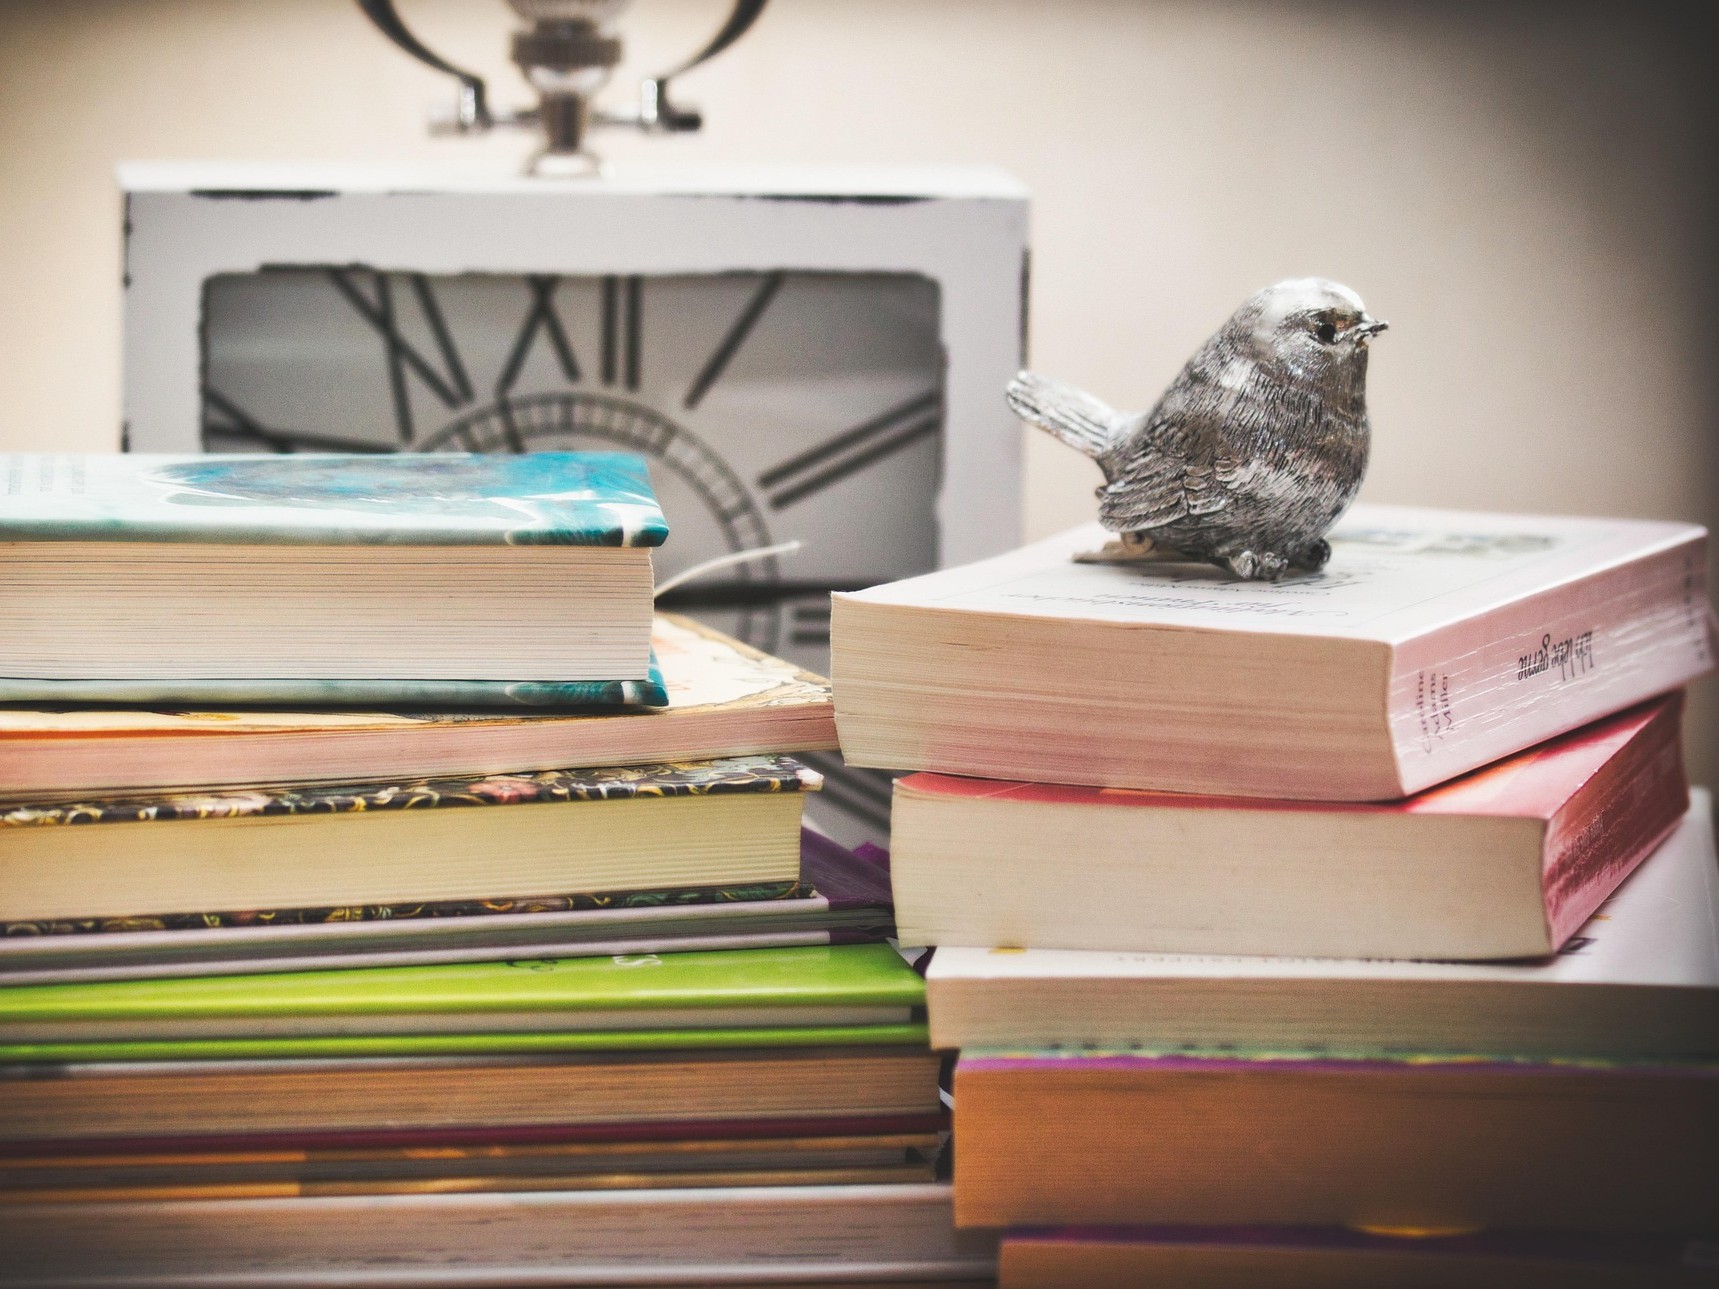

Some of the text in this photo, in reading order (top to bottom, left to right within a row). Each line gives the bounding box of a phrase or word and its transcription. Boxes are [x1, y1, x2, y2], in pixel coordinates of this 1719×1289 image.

[1517, 634, 1550, 681] gerne
[1416, 670, 1432, 754] Caroline
[1430, 672, 1444, 739] Adams
[1441, 673, 1455, 731] Miller
